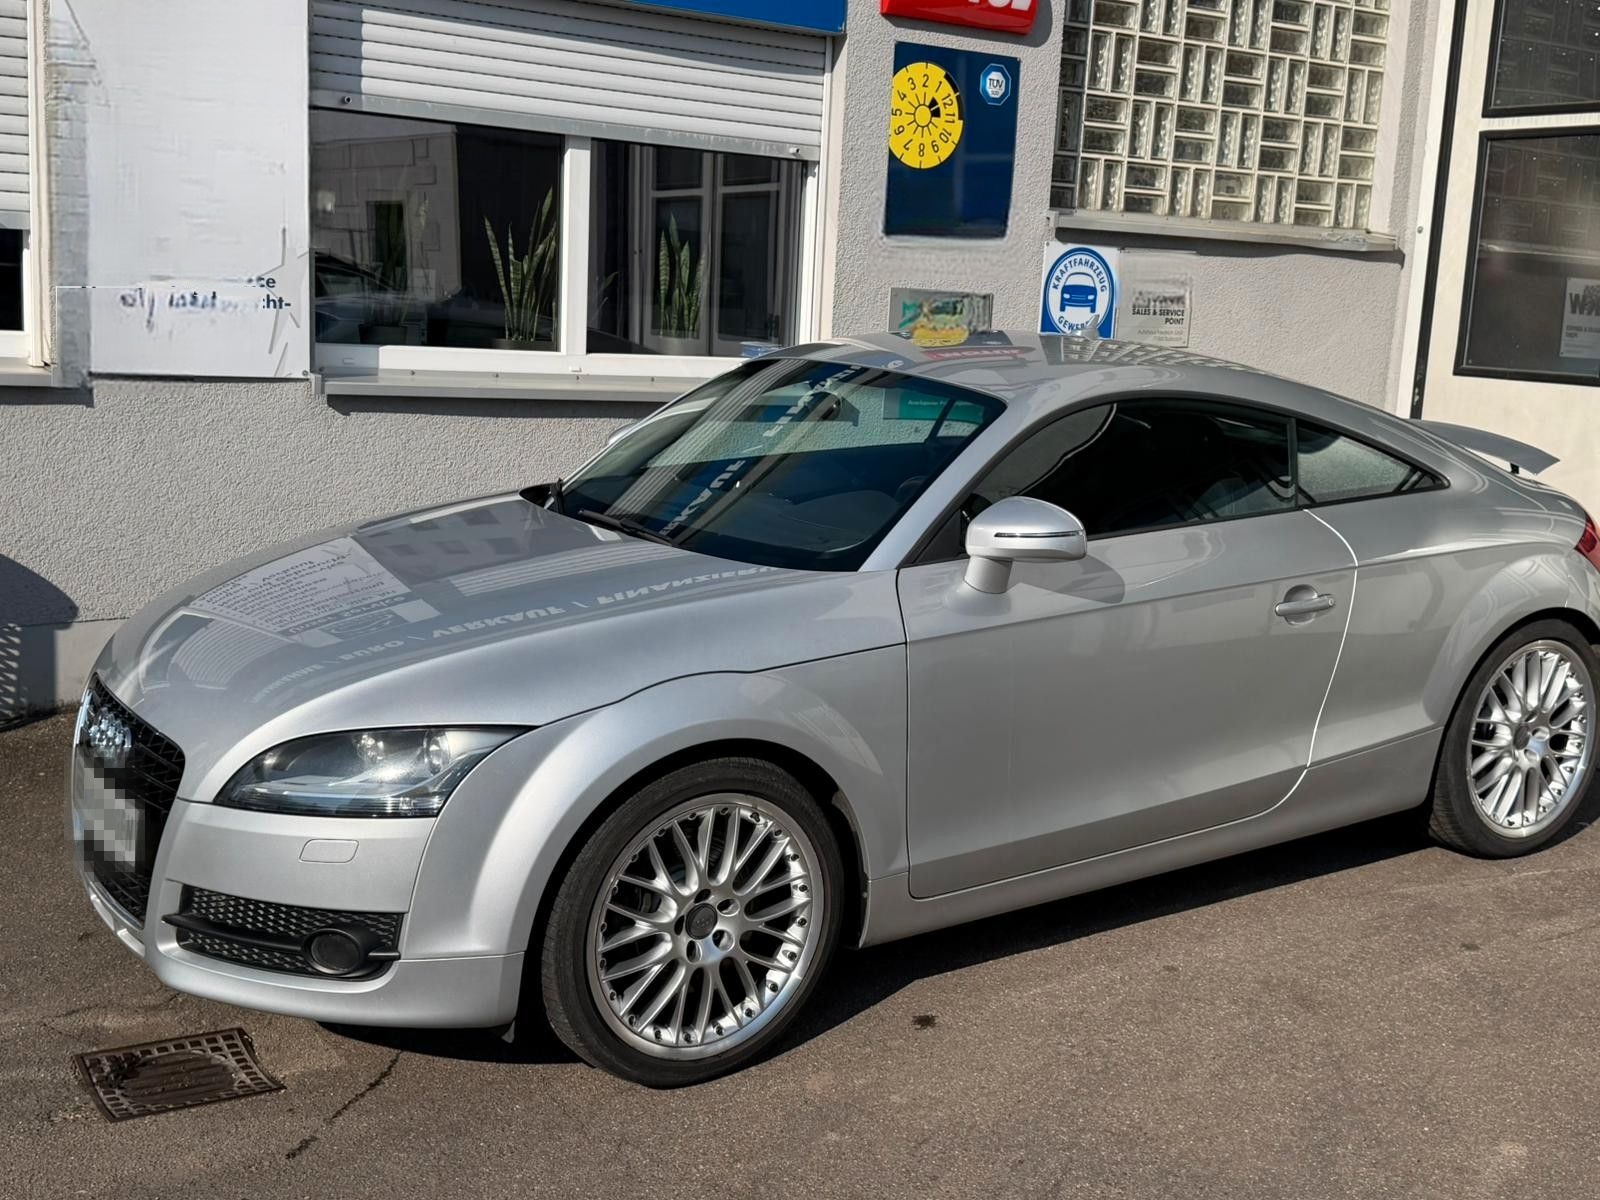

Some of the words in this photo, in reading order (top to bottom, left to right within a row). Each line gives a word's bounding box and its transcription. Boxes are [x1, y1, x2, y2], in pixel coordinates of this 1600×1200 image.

[907, 77, 917, 91] 3
[922, 74, 930, 88] 2
[935, 81, 943, 92] 1
[897, 90, 907, 101] 4
[941, 93, 954, 109] 12
[891, 108, 903, 117] 5
[945, 112, 956, 125] 11
[894, 125, 905, 136] 6
[939, 128, 953, 144] 10
[903, 139, 913, 151] 7
[918, 143, 925, 157] 8
[931, 140, 939, 153] 9
[1052, 258, 1107, 293] KRAFTFAHRZEUG
[1132, 308, 1151, 316] SALES
[1159, 309, 1185, 317] SERVICE
[1058, 316, 1090, 330] GEWER
